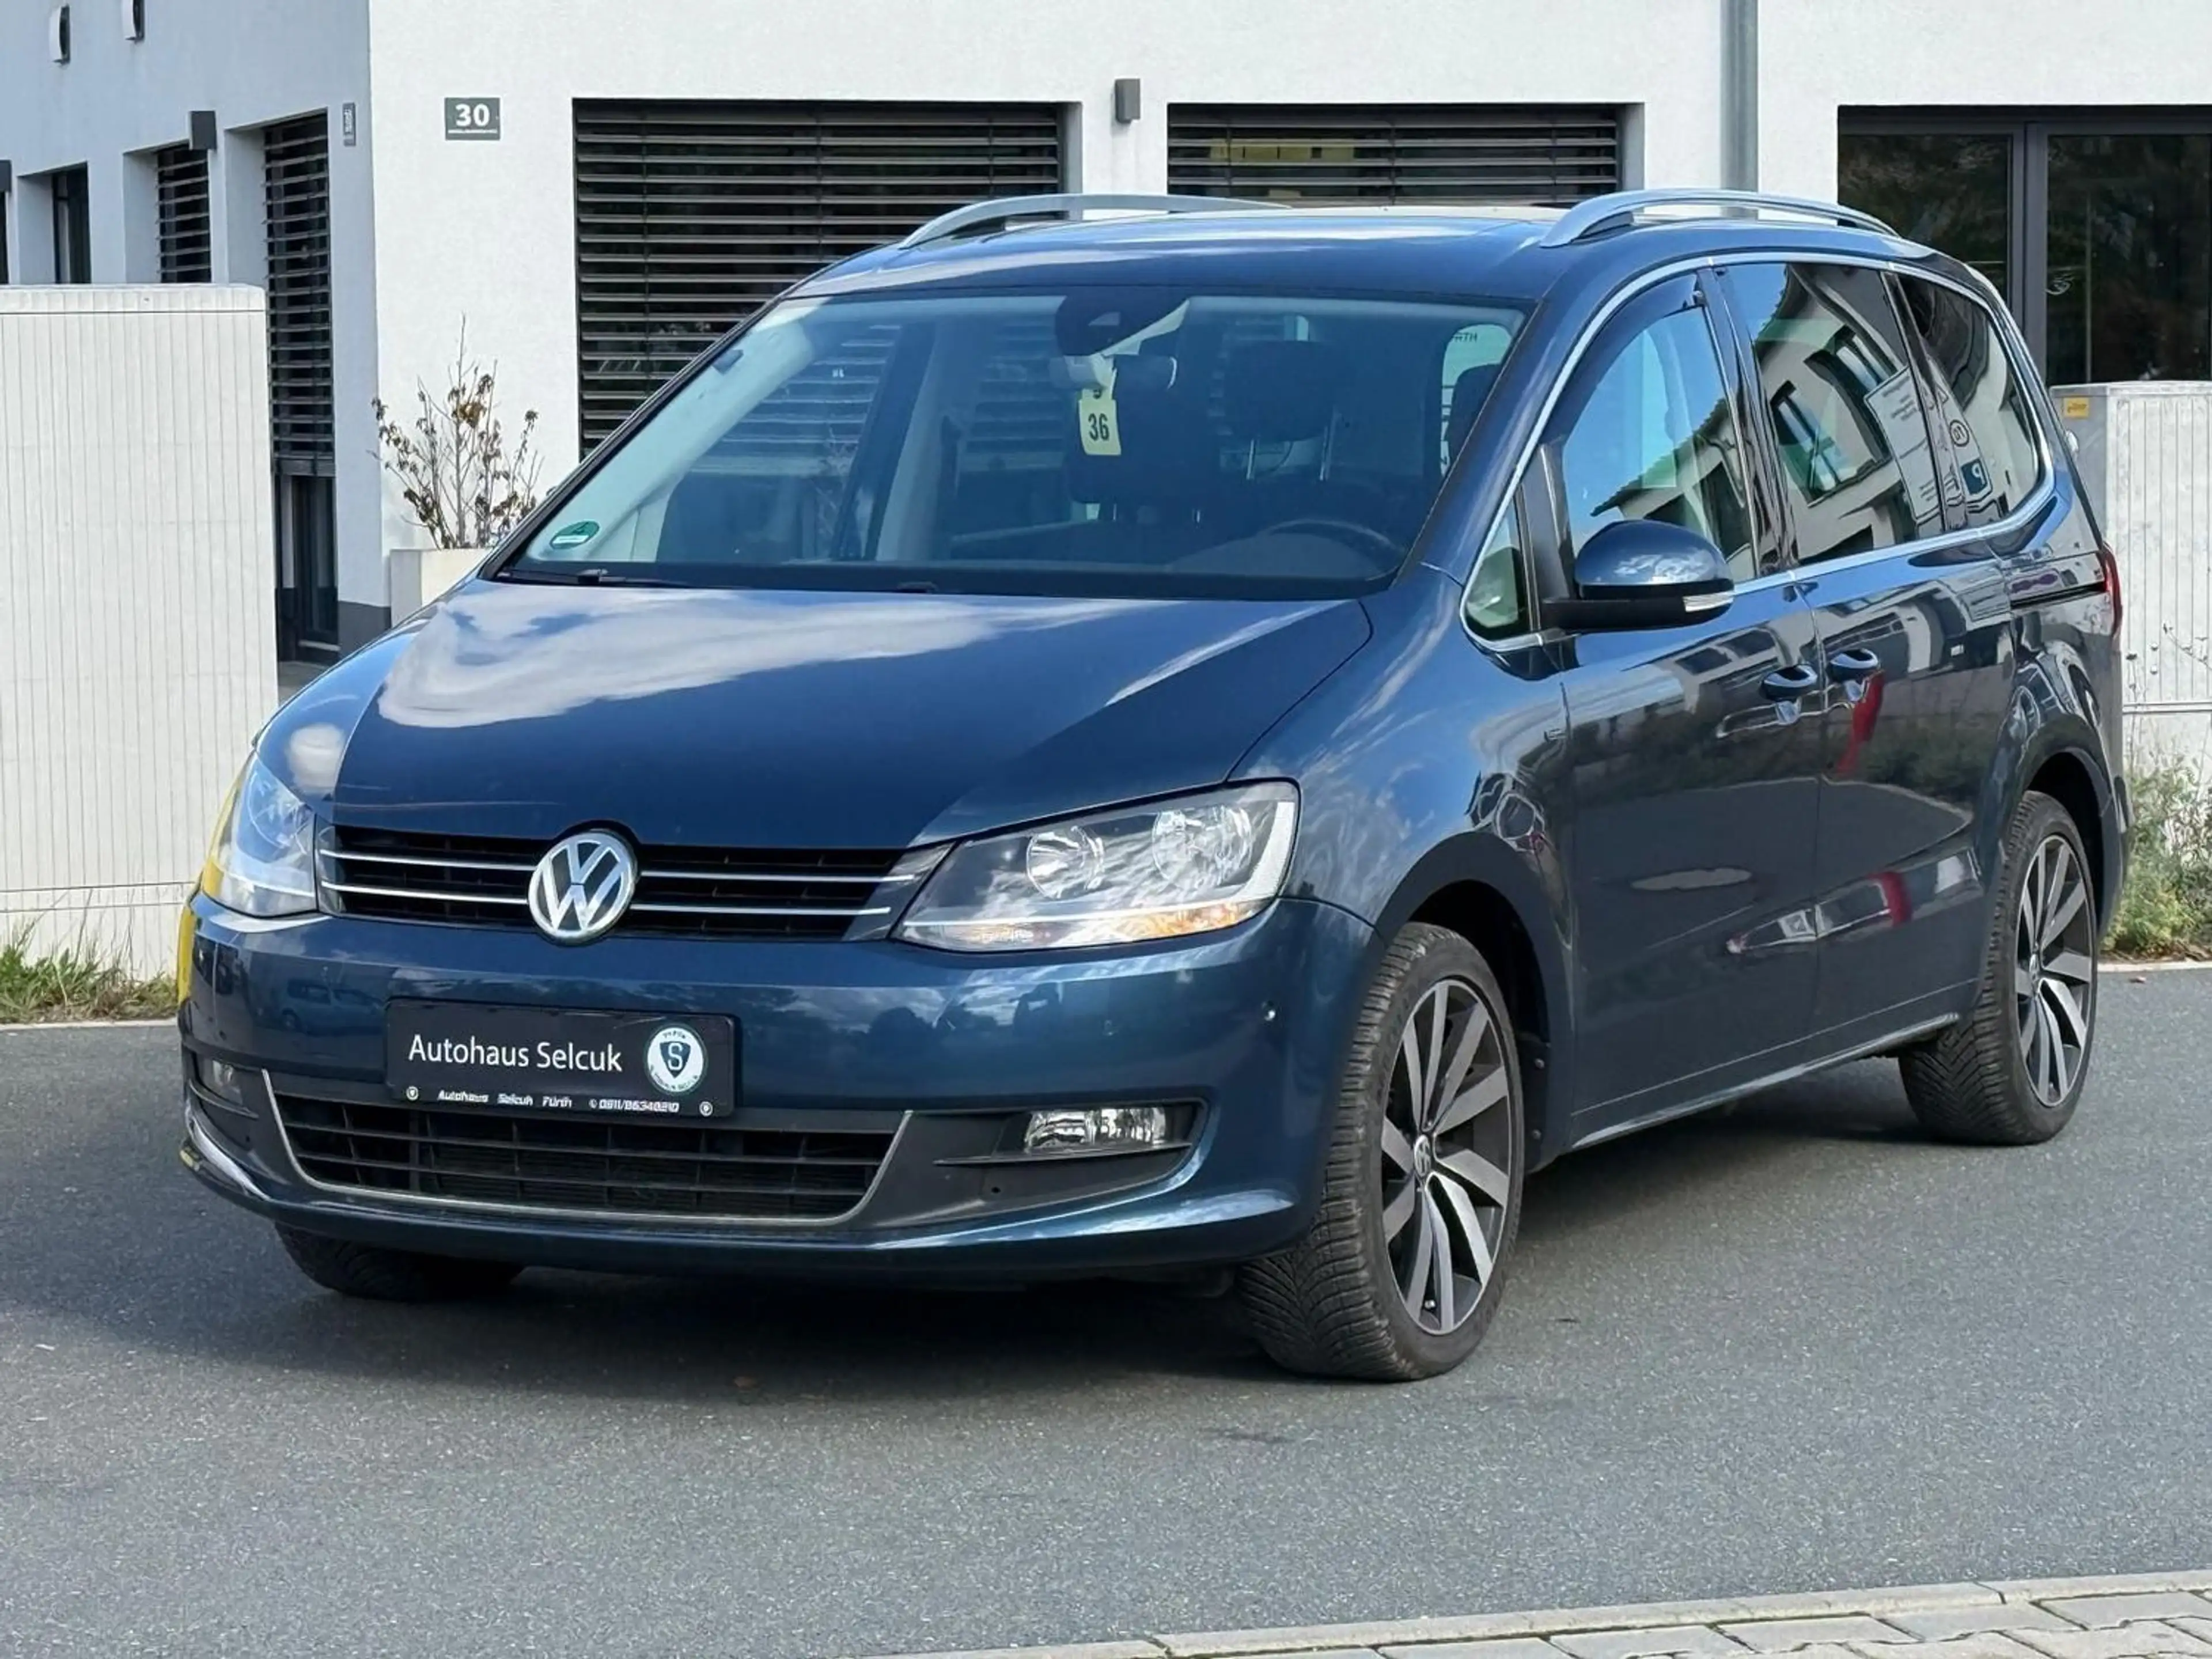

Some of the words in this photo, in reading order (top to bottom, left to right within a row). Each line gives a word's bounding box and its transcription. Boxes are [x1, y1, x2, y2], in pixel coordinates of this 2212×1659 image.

[455, 103, 490, 126] 30
[1088, 412, 1109, 441] 36
[408, 1034, 529, 1067] Autohaus
[537, 1041, 623, 1071] Selcuk
